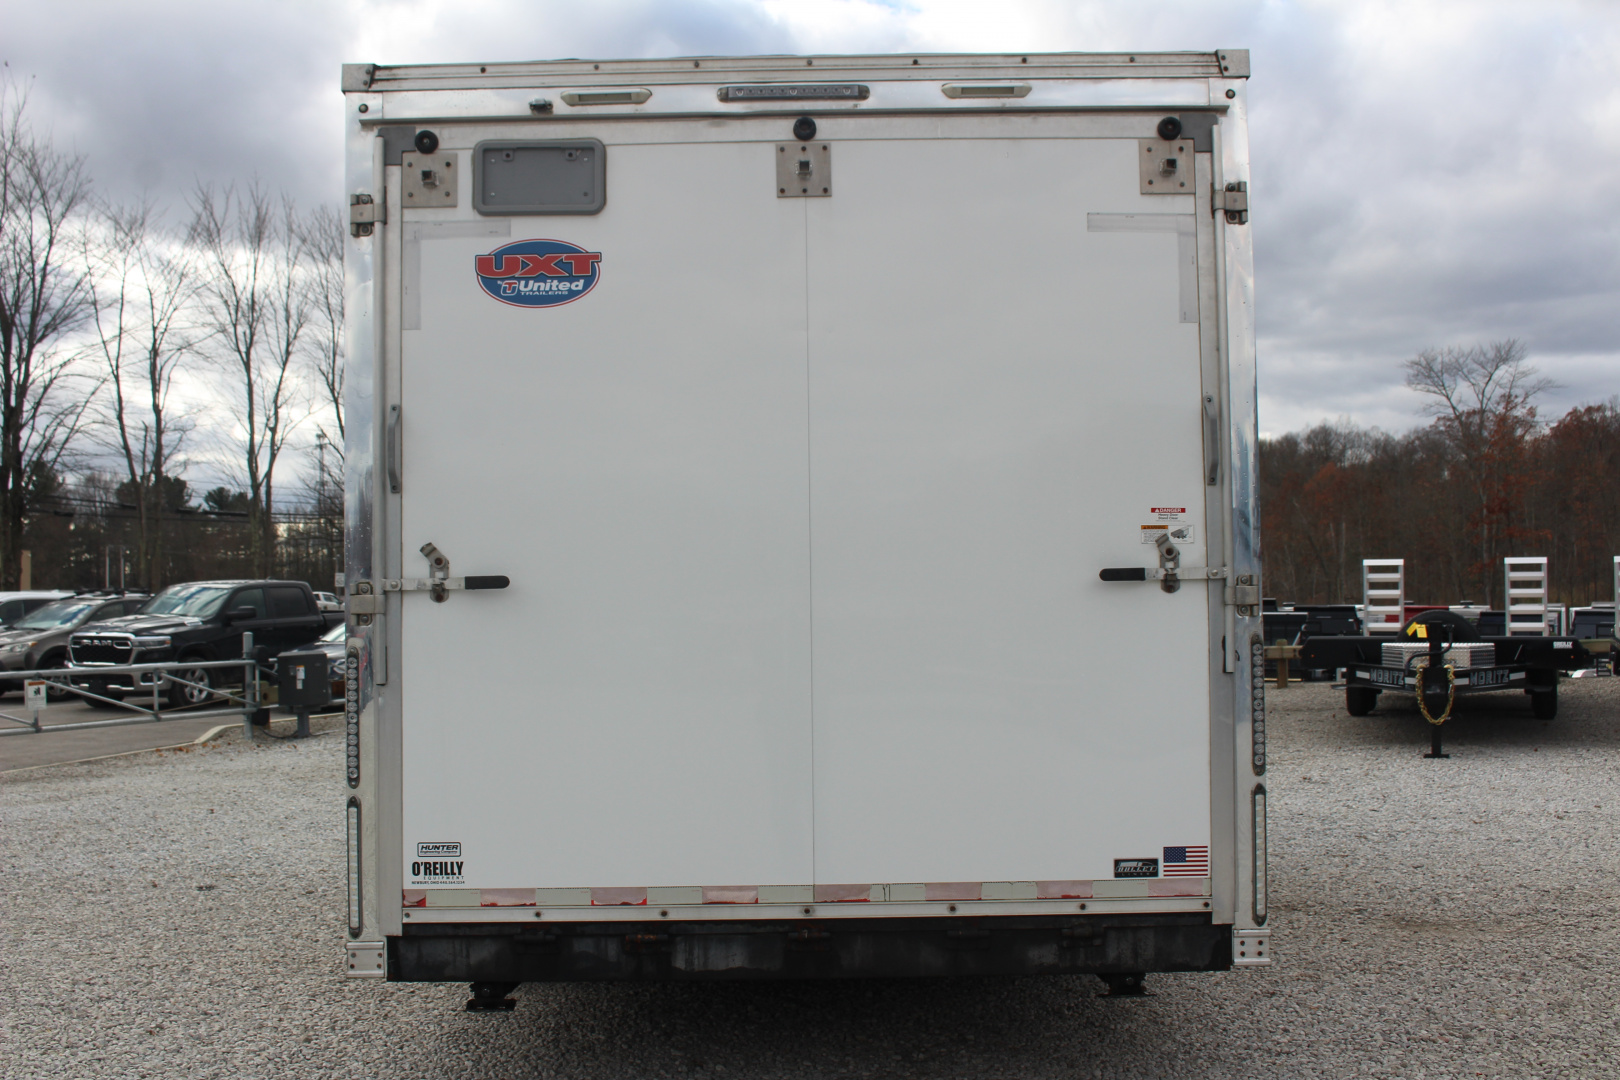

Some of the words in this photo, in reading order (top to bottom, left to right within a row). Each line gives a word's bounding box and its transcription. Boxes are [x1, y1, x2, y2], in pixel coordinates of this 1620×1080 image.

[475, 253, 601, 278] UXT
[519, 279, 584, 291] United
[1370, 669, 1404, 685] MORITZ
[1470, 669, 1509, 685] MORITZ
[412, 861, 464, 876] O'REILLY
